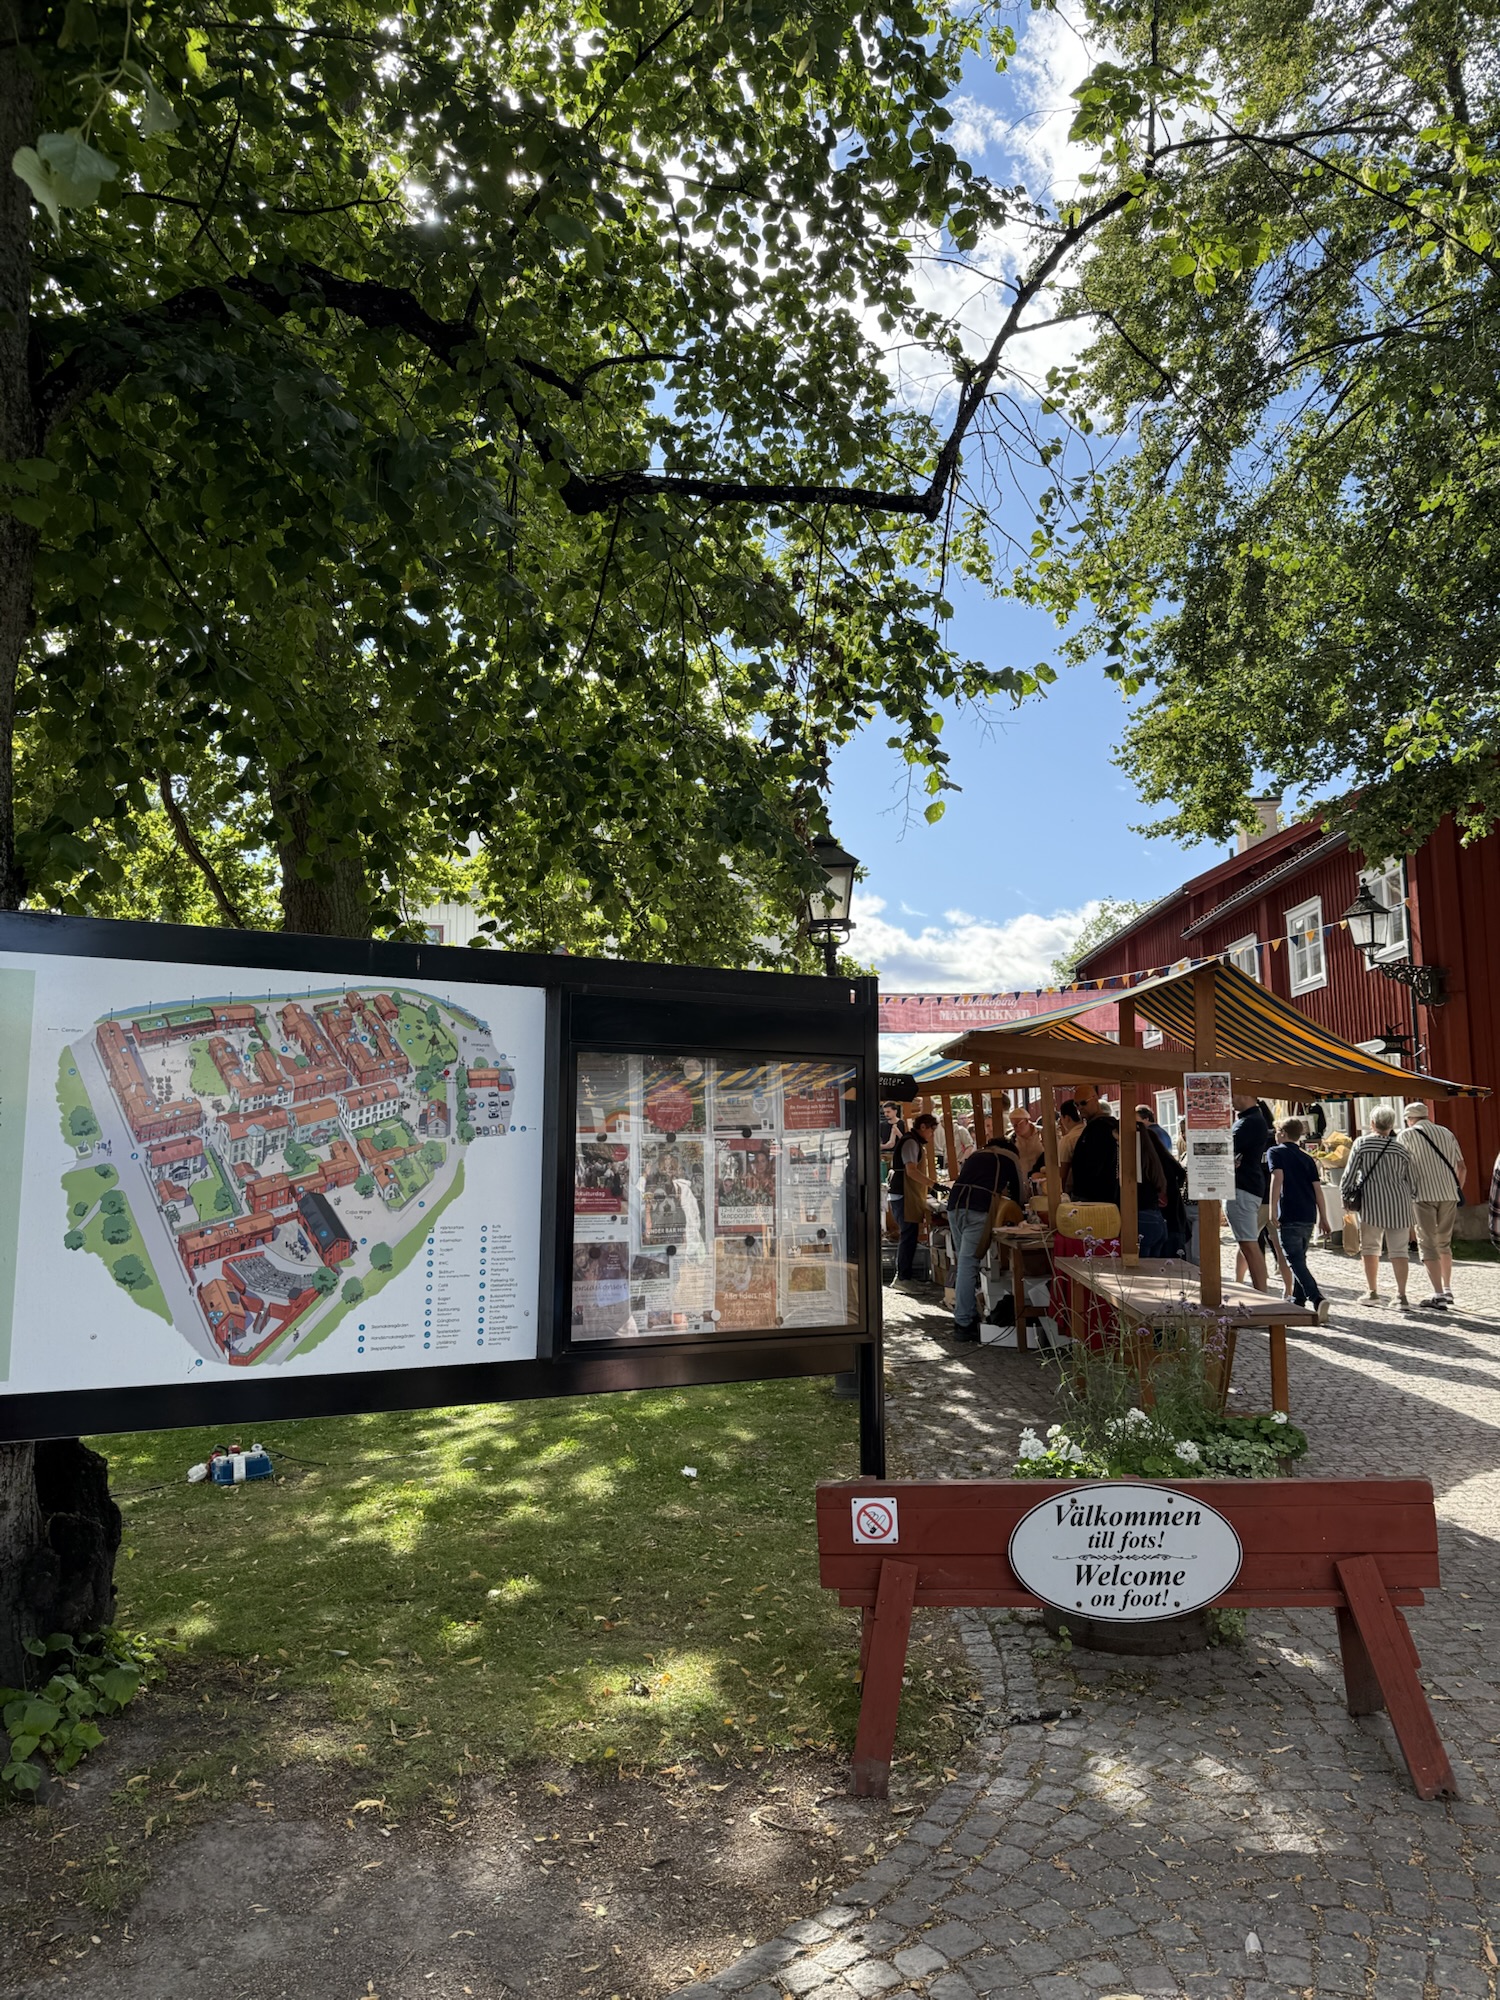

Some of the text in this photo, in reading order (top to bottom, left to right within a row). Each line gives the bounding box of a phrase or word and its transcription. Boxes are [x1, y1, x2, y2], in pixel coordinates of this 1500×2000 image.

[939, 1009, 1031, 1020] MATMARKNAD
[879, 1076, 905, 1086] eater-
[1056, 1504, 1202, 1526] Välkommen
[1088, 1531, 1165, 1554] till fots!
[1076, 1564, 1186, 1586] Welcome
[1091, 1589, 1169, 1612] on foot!
